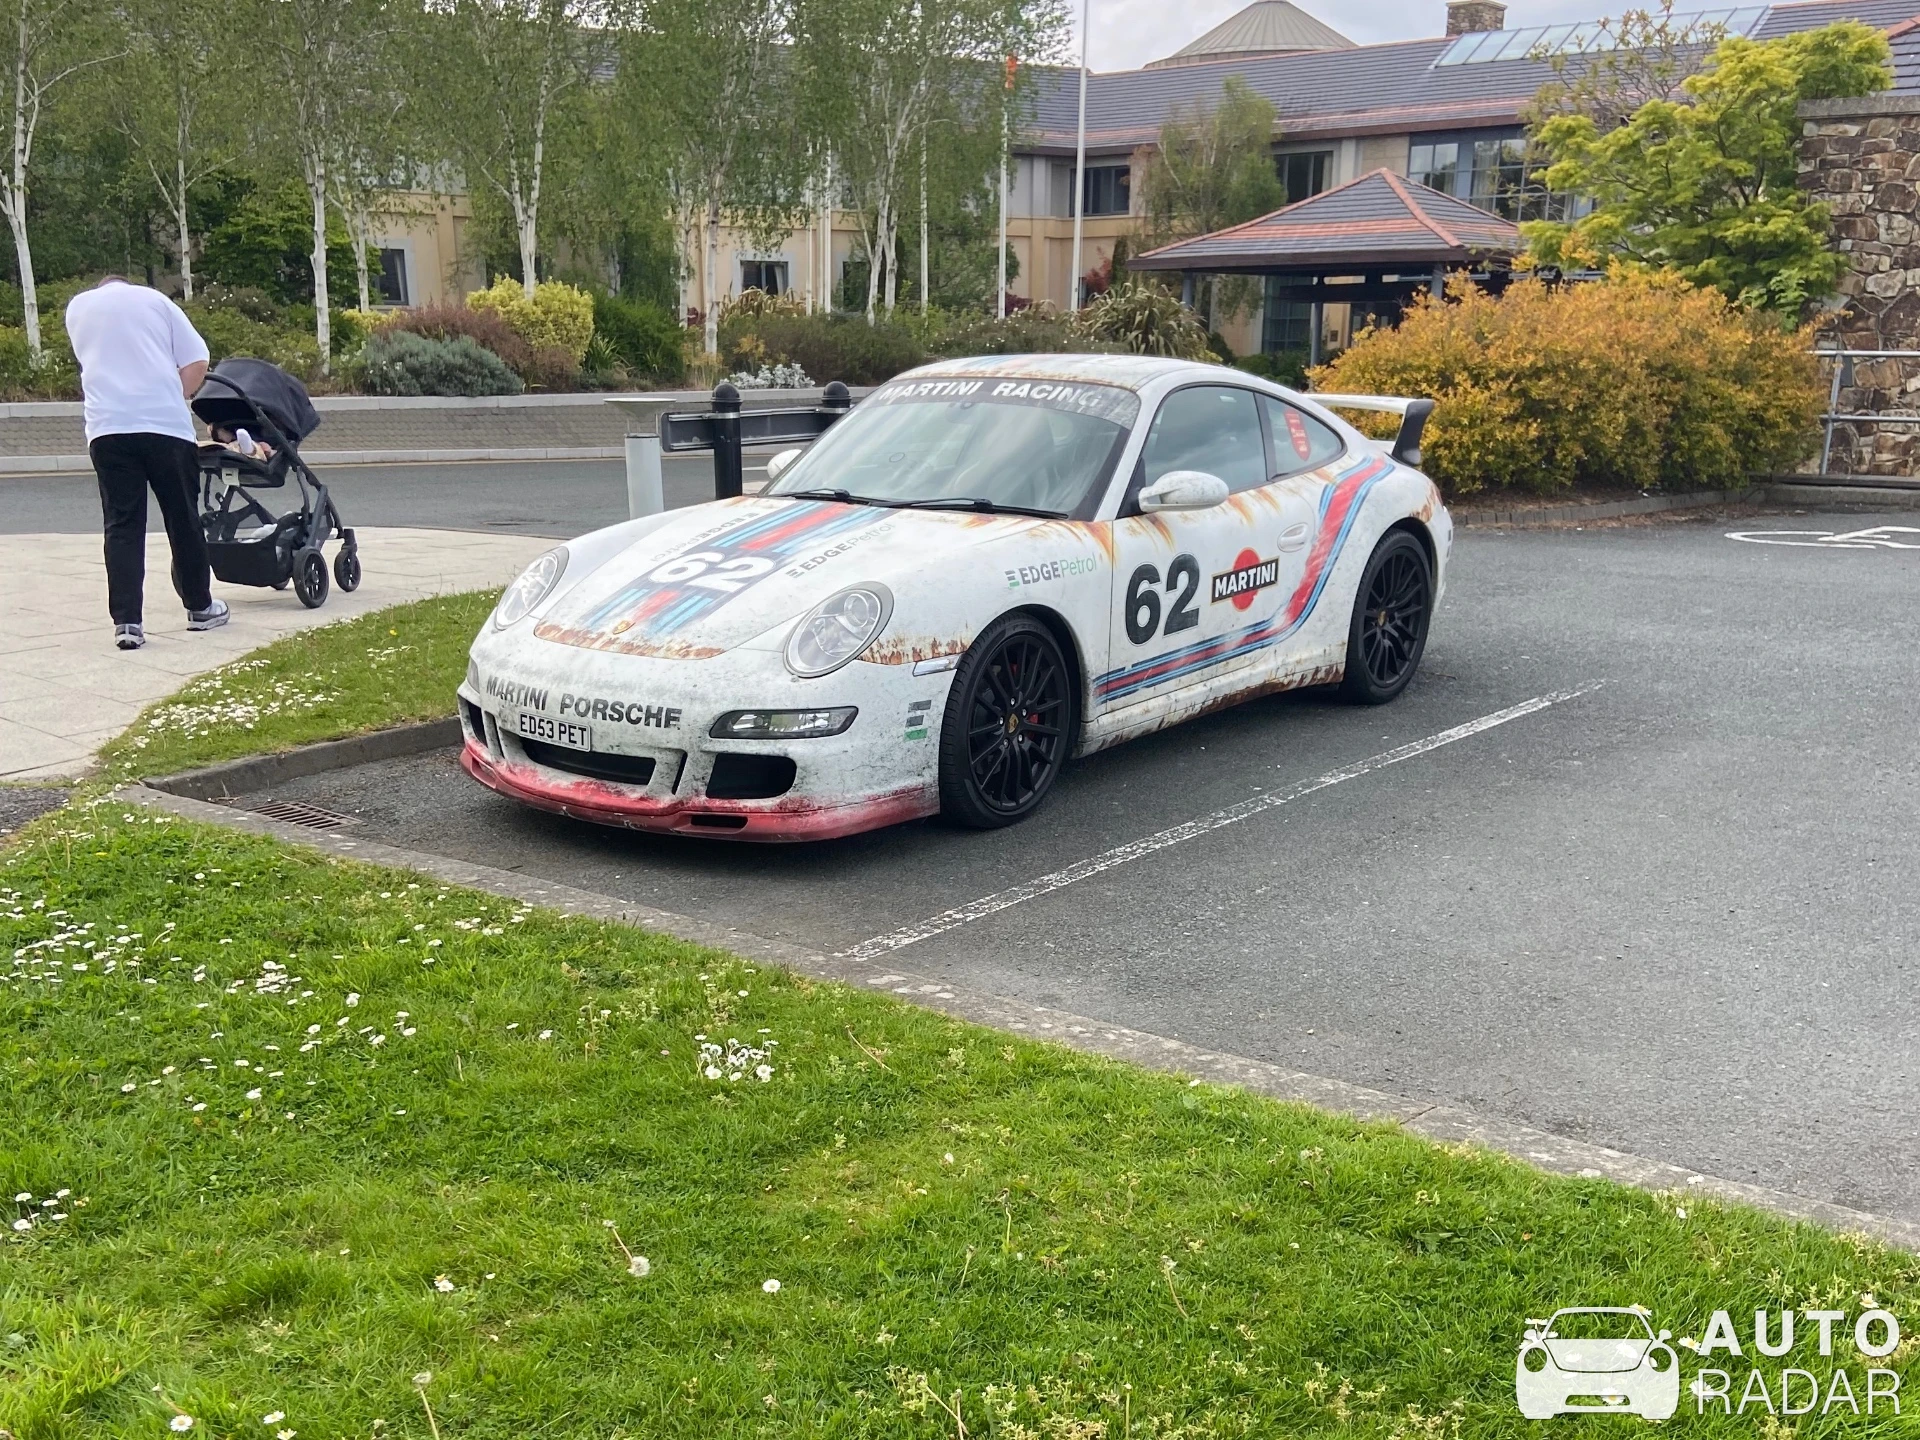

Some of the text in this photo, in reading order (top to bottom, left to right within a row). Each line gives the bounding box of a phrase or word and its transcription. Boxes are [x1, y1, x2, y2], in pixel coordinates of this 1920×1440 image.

[879, 381, 1102, 407] MARTINI RACING
[648, 551, 777, 592] 62
[1020, 553, 1097, 585] EDGEPetrol
[1214, 561, 1276, 598] MARTINI
[1125, 552, 1200, 645] 62
[486, 675, 683, 730] MARTINI PORSCHE
[520, 713, 554, 739] ED53
[558, 722, 587, 746] PET
